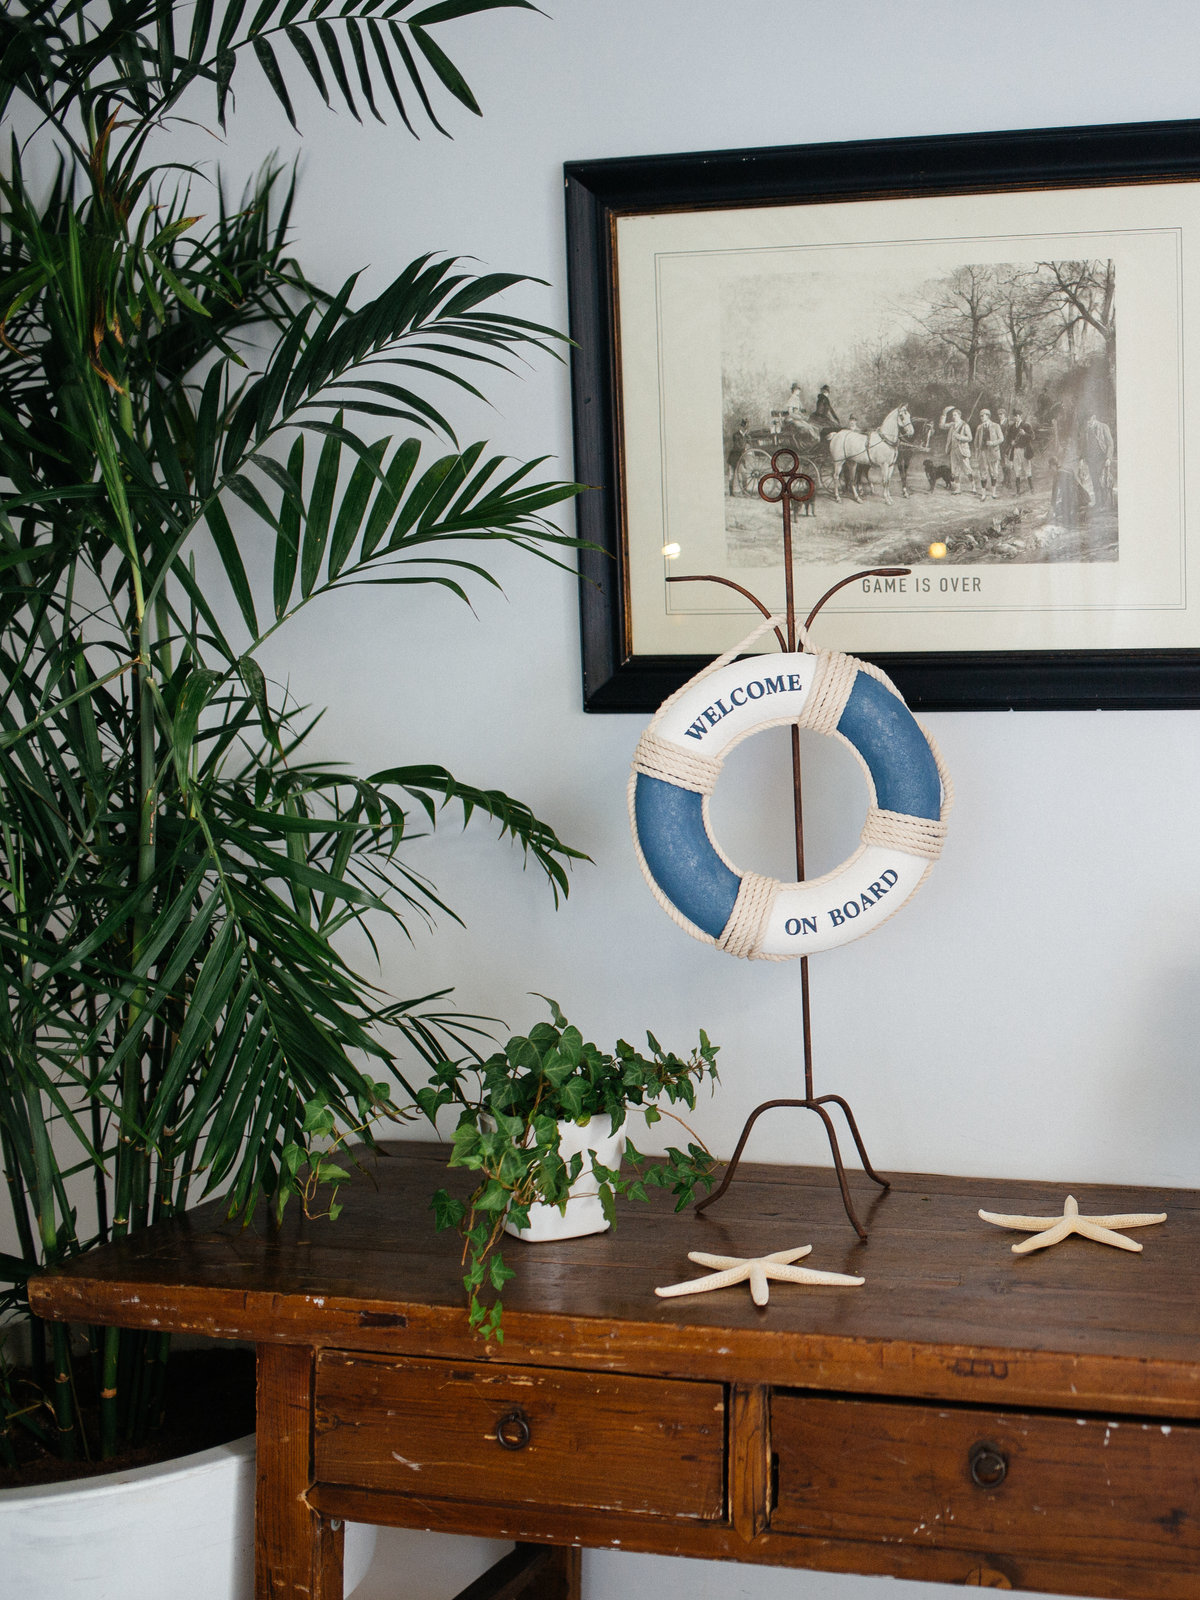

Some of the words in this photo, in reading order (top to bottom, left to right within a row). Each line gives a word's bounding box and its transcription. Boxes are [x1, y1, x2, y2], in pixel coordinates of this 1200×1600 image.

[862, 578, 907, 593] GAME
[915, 578, 931, 592] IS
[939, 577, 981, 592] OVER
[684, 674, 802, 740] WELCOME
[785, 916, 818, 935] ON
[827, 868, 898, 927] BOARD
